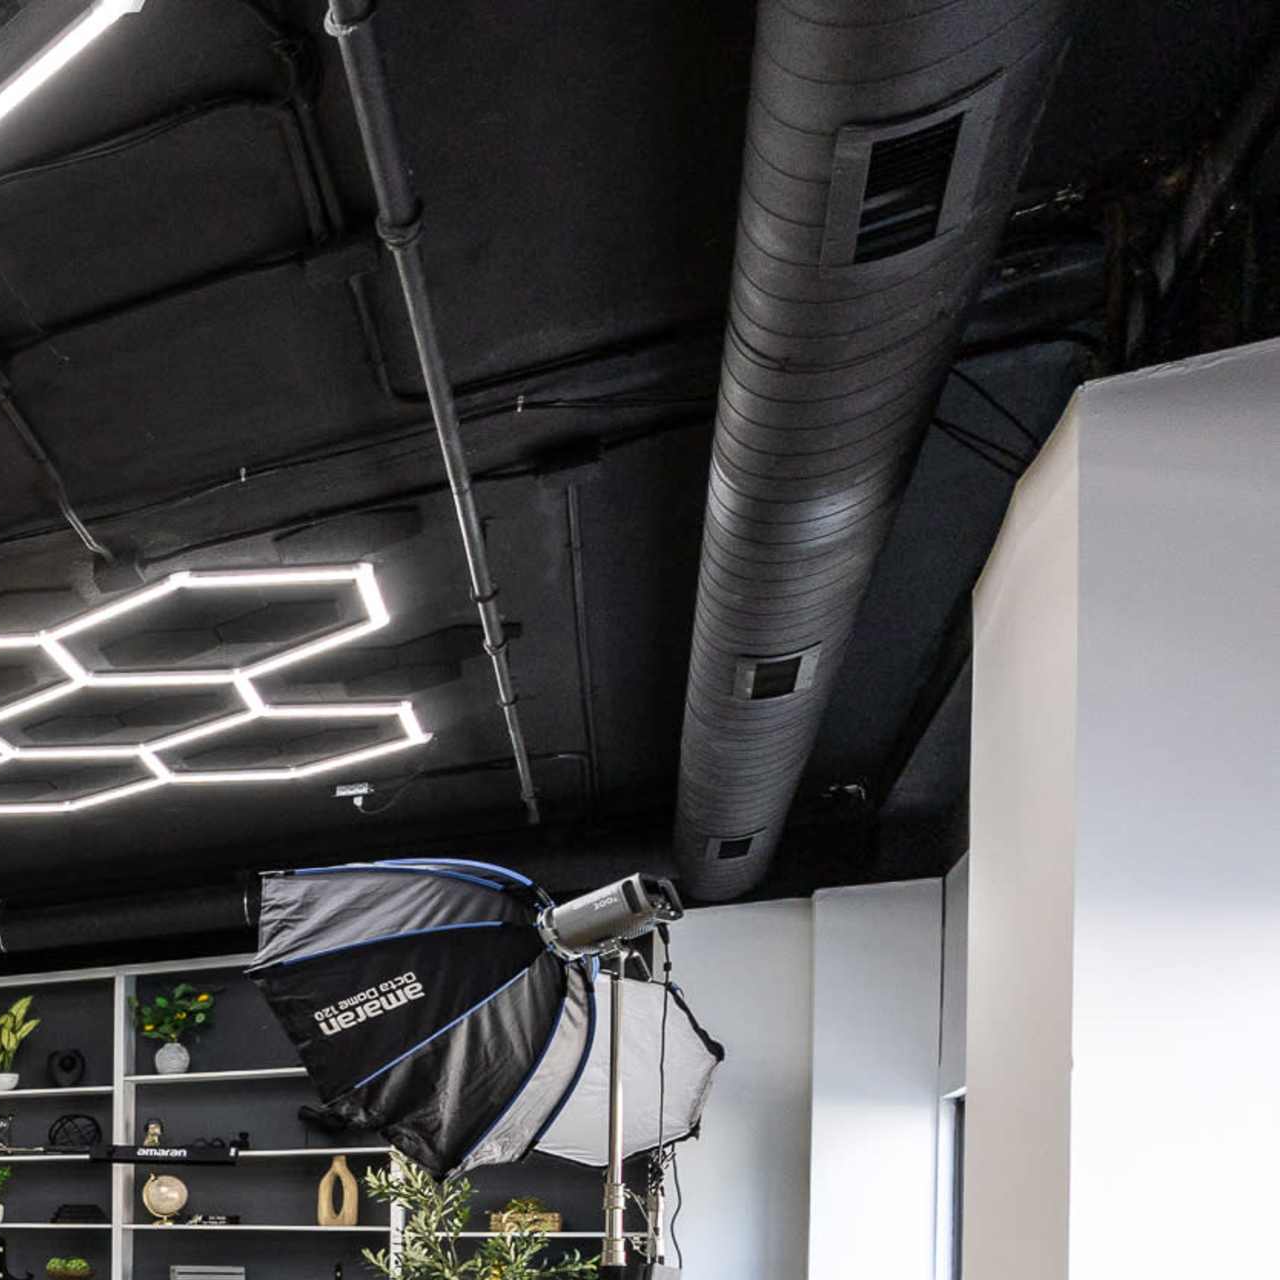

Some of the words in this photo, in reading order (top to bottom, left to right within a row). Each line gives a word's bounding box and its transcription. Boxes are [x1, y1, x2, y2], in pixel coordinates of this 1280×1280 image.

[378, 971, 417, 992] Octa
[337, 986, 379, 1010] Dome
[313, 1004, 339, 1021] 120
[318, 982, 425, 1036] amaran
[136, 1147, 188, 1158] amaran
